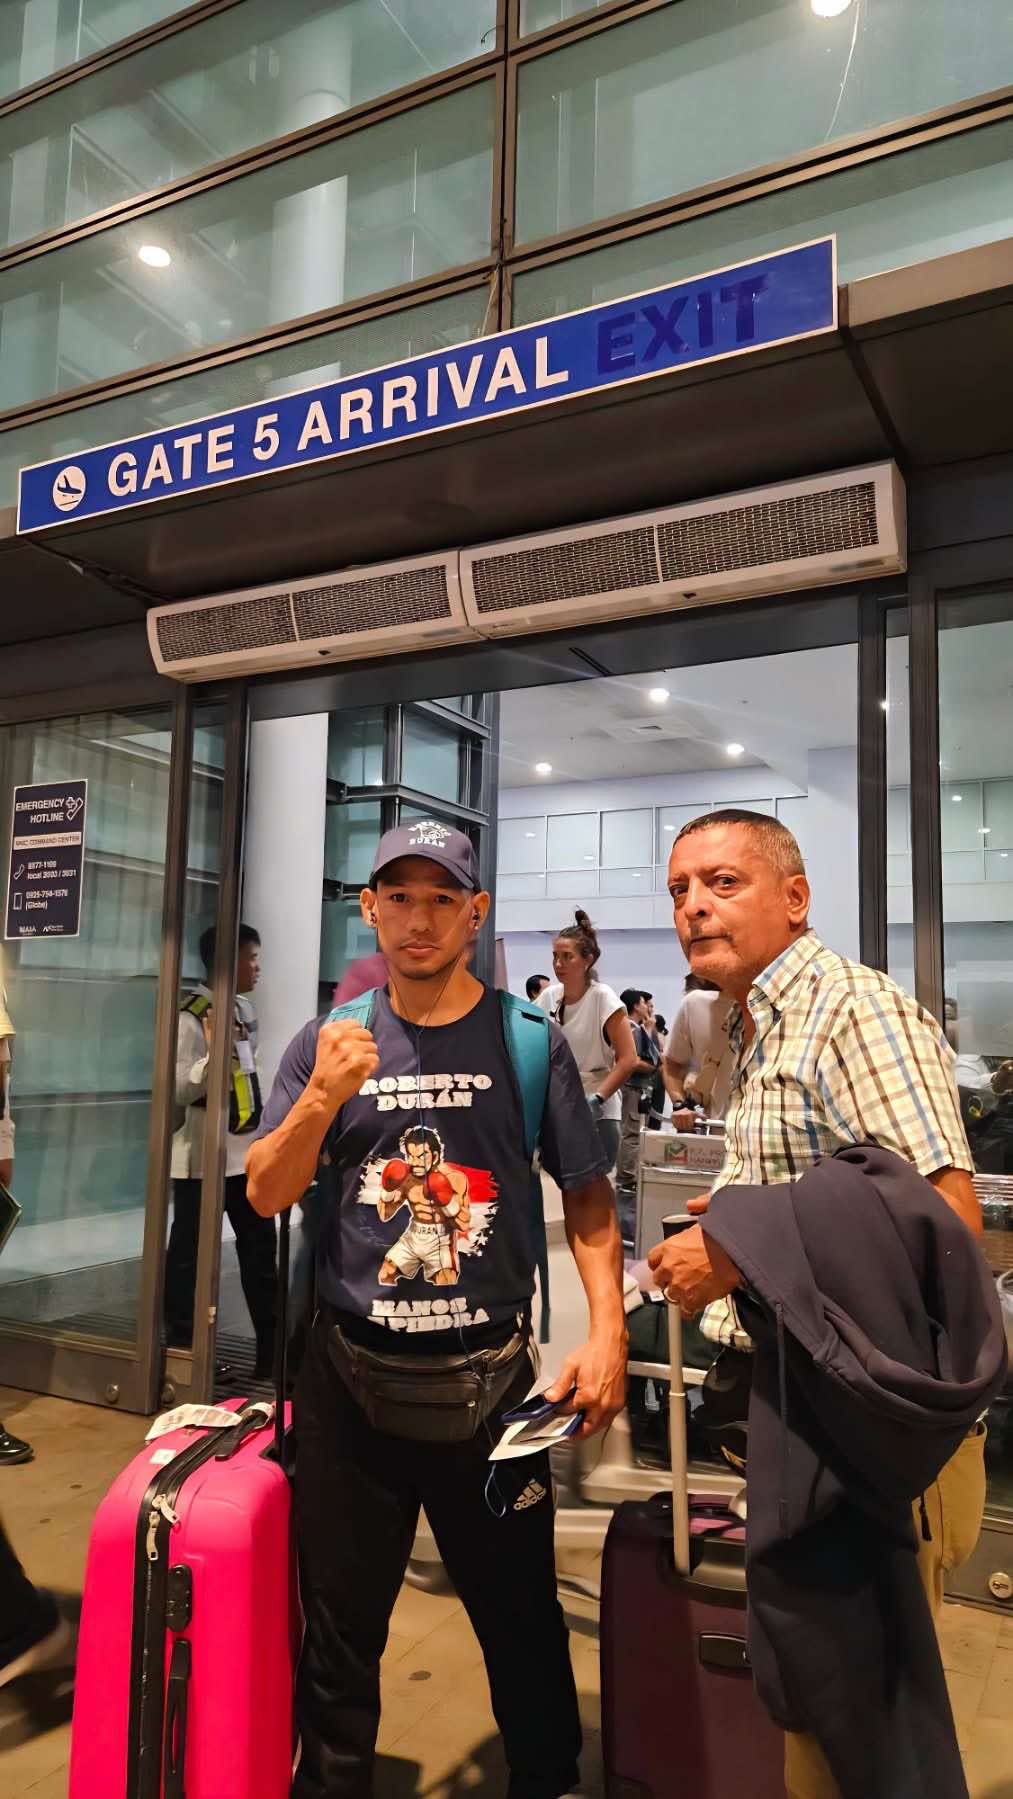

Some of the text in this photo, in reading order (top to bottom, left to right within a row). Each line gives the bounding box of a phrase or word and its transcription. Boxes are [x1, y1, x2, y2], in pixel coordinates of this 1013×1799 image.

[107, 274, 766, 497] GATE 5 ARRIVAL EXIT
[15, 798, 65, 812] EMERGENCY
[30, 812, 65, 823] HOTLINE
[358, 1073, 493, 1096] ROBERTO
[376, 1088, 473, 1111] DURÁN
[371, 1297, 468, 1316] MANOS
[513, 1488, 546, 1510] adidas
